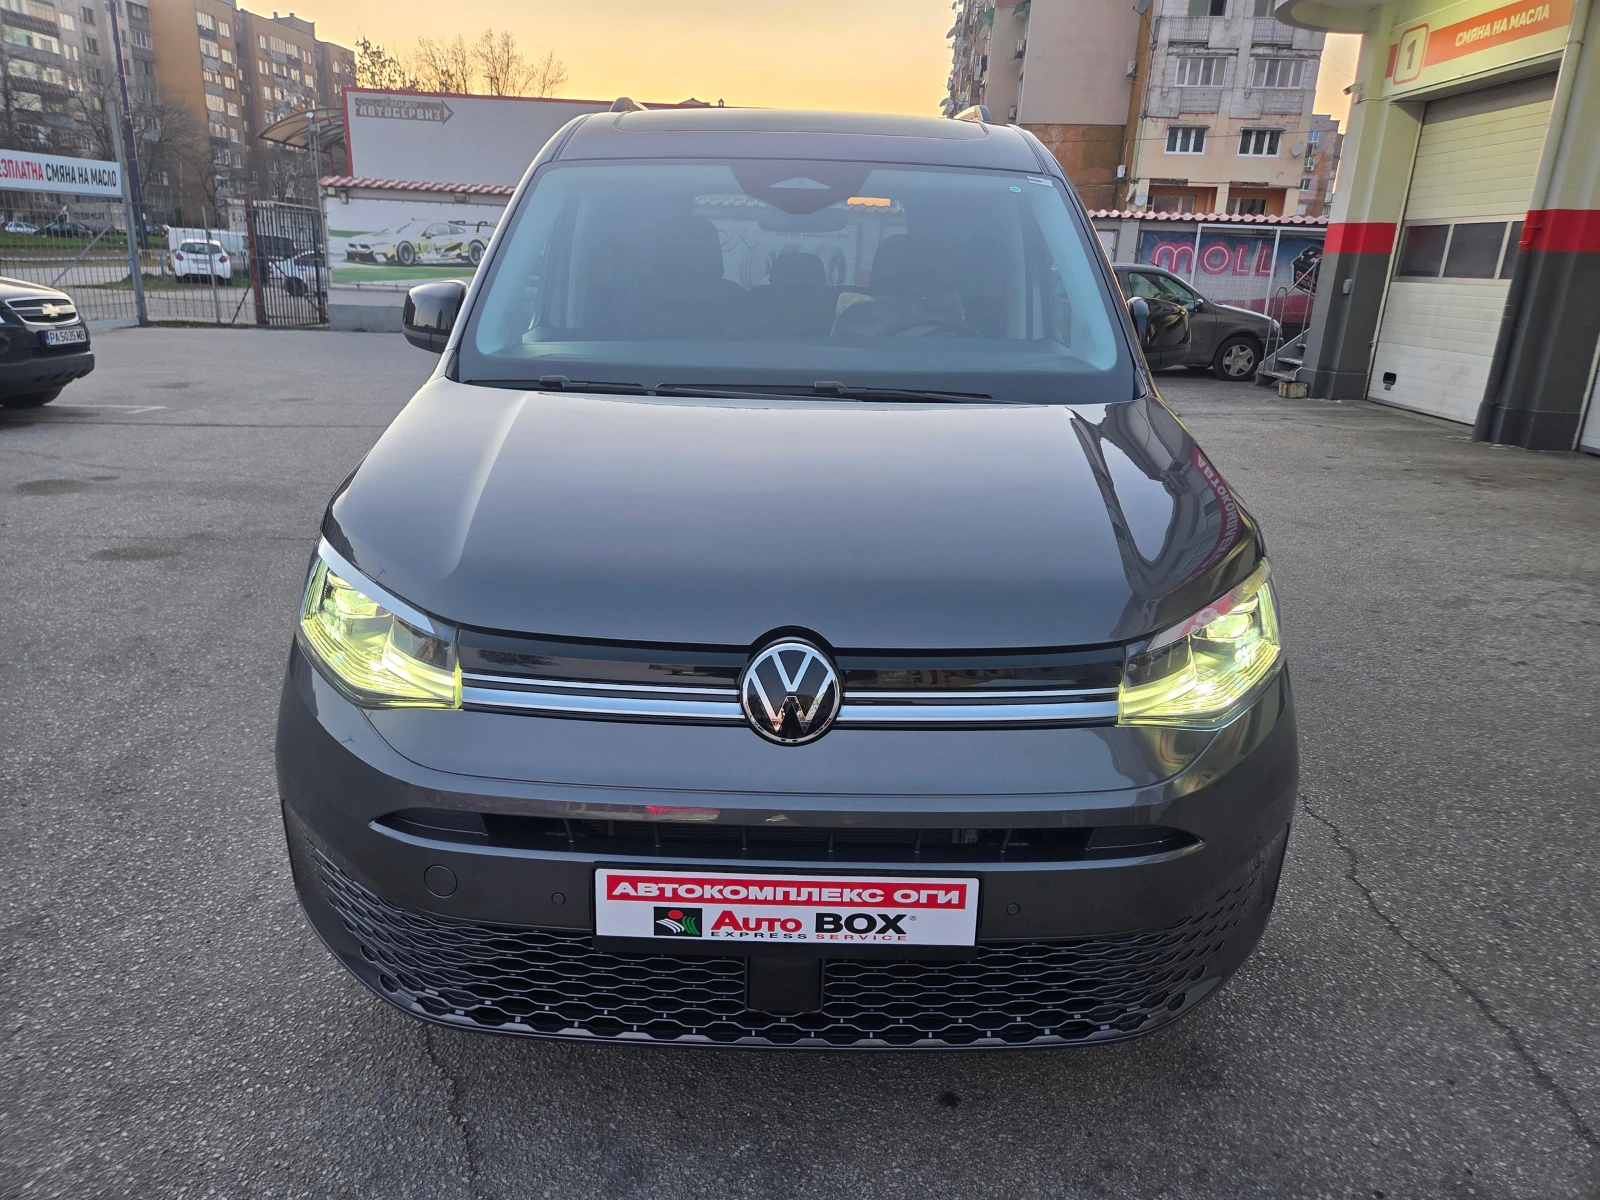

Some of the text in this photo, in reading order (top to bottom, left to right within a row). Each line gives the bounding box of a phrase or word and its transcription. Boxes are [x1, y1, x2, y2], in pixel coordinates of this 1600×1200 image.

[1455, 4, 1550, 47] СМЯНА НА МАСЛА
[1406, 38, 1418, 71] 1
[360, 105, 441, 121] АВТОСЕРВИЗ
[45, 163, 77, 184] СМЯНА
[77, 166, 89, 185] НА
[90, 168, 117, 188] МАСЛО
[1151, 241, 1277, 277] MOLL
[611, 882, 960, 905] АВТОКОМПЛЕКС ОГИ
[711, 931, 907, 942] EXPRESS SERVICE
